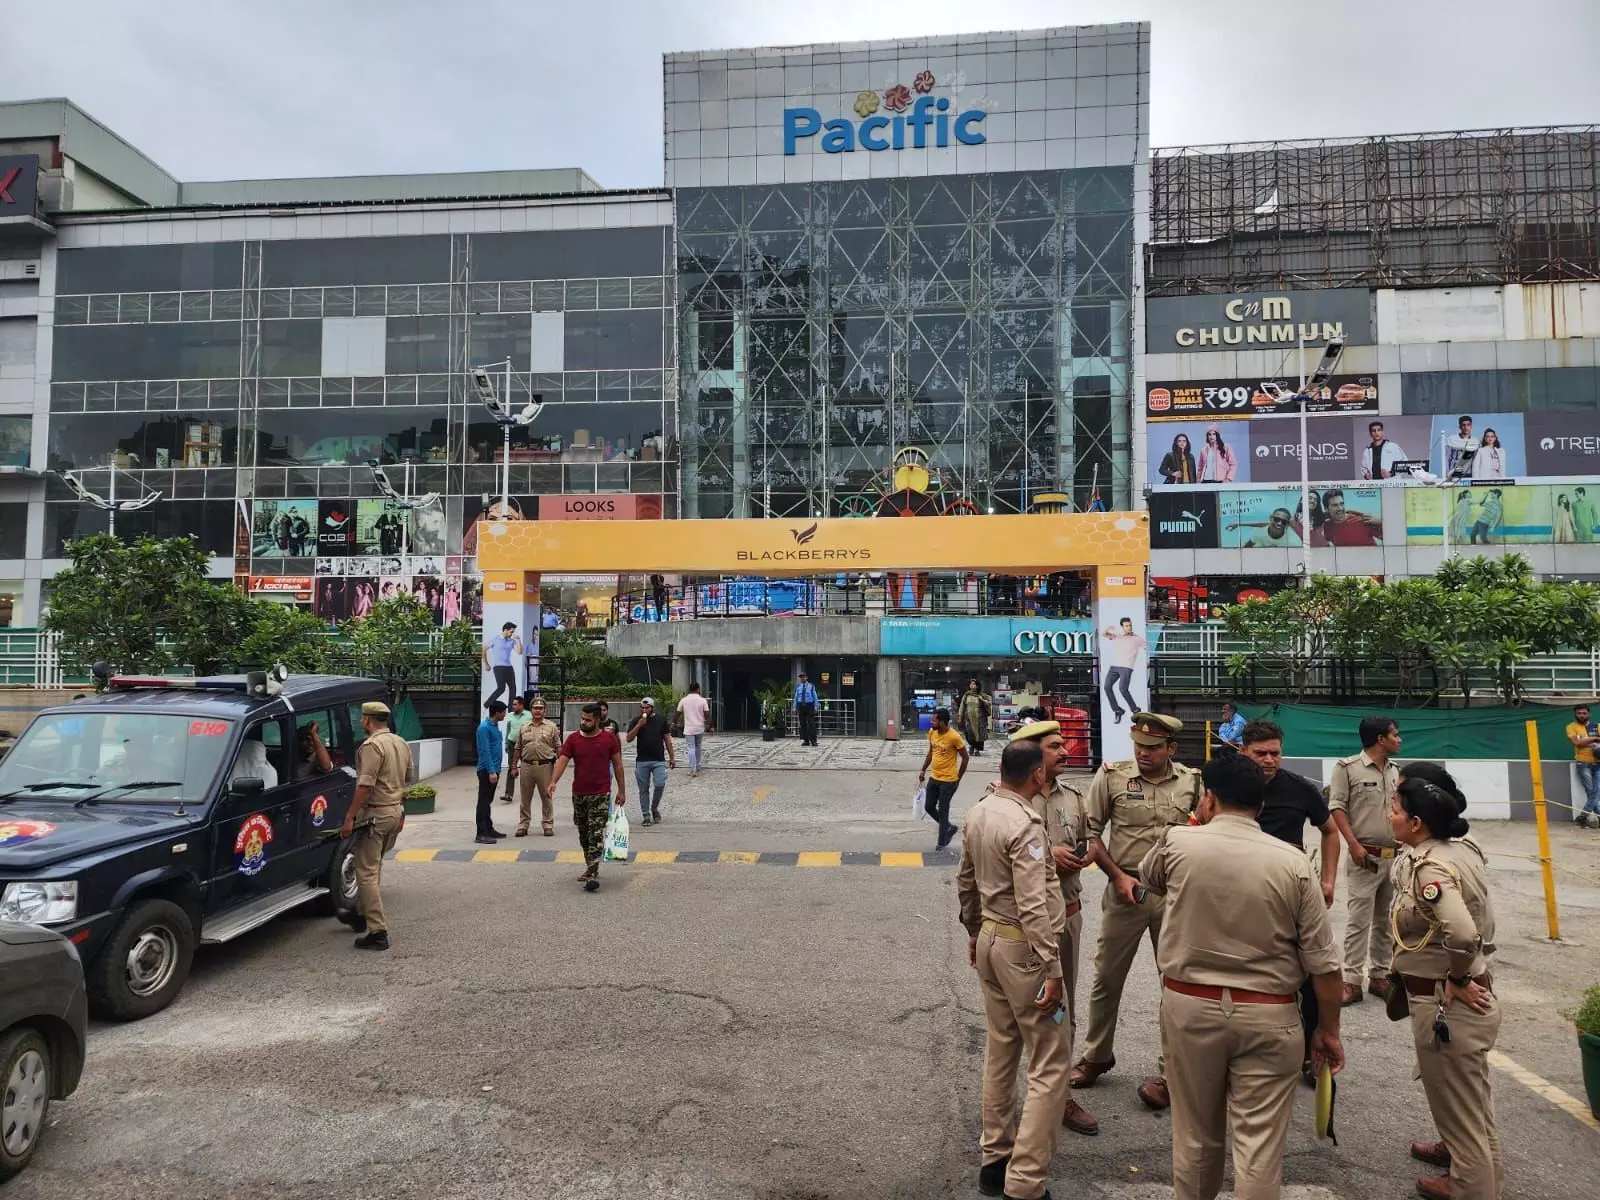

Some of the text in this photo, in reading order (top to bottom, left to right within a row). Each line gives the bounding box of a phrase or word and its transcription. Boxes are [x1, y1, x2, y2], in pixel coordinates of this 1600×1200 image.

[784, 95, 987, 156] Pacific
[1176, 322, 1343, 347] CHUNMUN
[1173, 388, 1202, 397] TASTY
[1173, 396, 1203, 404] MEALS
[1270, 442, 1348, 457] TRENDS
[565, 500, 615, 513] LOOKS
[1159, 521, 1196, 533] PUMA
[737, 549, 871, 561] BLACKBERRYS
[1014, 629, 1095, 654] crom
